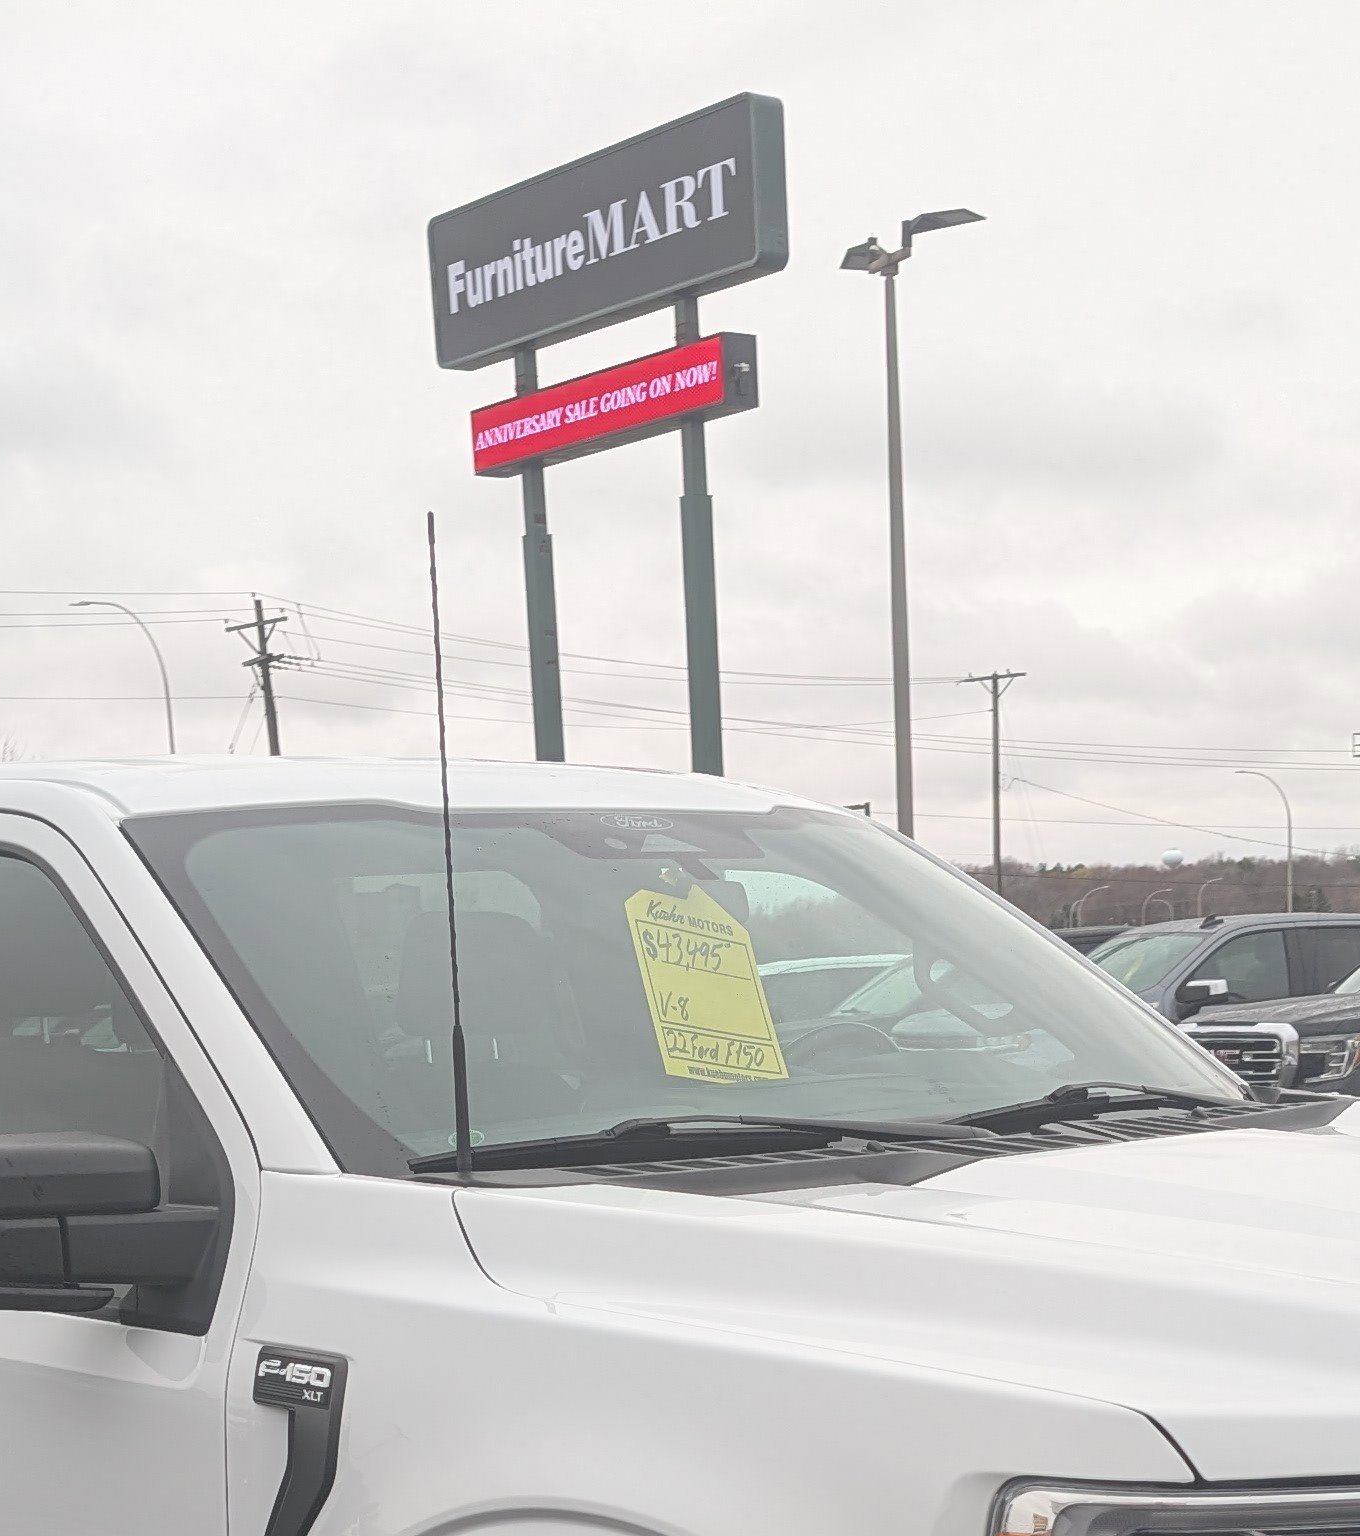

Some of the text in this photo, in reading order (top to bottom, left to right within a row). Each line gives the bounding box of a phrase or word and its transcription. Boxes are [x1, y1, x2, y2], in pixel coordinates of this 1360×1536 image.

[446, 157, 737, 314] FurnitureMART
[475, 360, 718, 450] ANNIVERSARY SALE GOING ON NOW!
[687, 915, 733, 936] MOTORS
[659, 991, 689, 1021] V-8
[666, 1028, 690, 1054] 22
[691, 1032, 720, 1063] Ford
[257, 1359, 332, 1388] F-150
[301, 1389, 323, 1402] XLT
